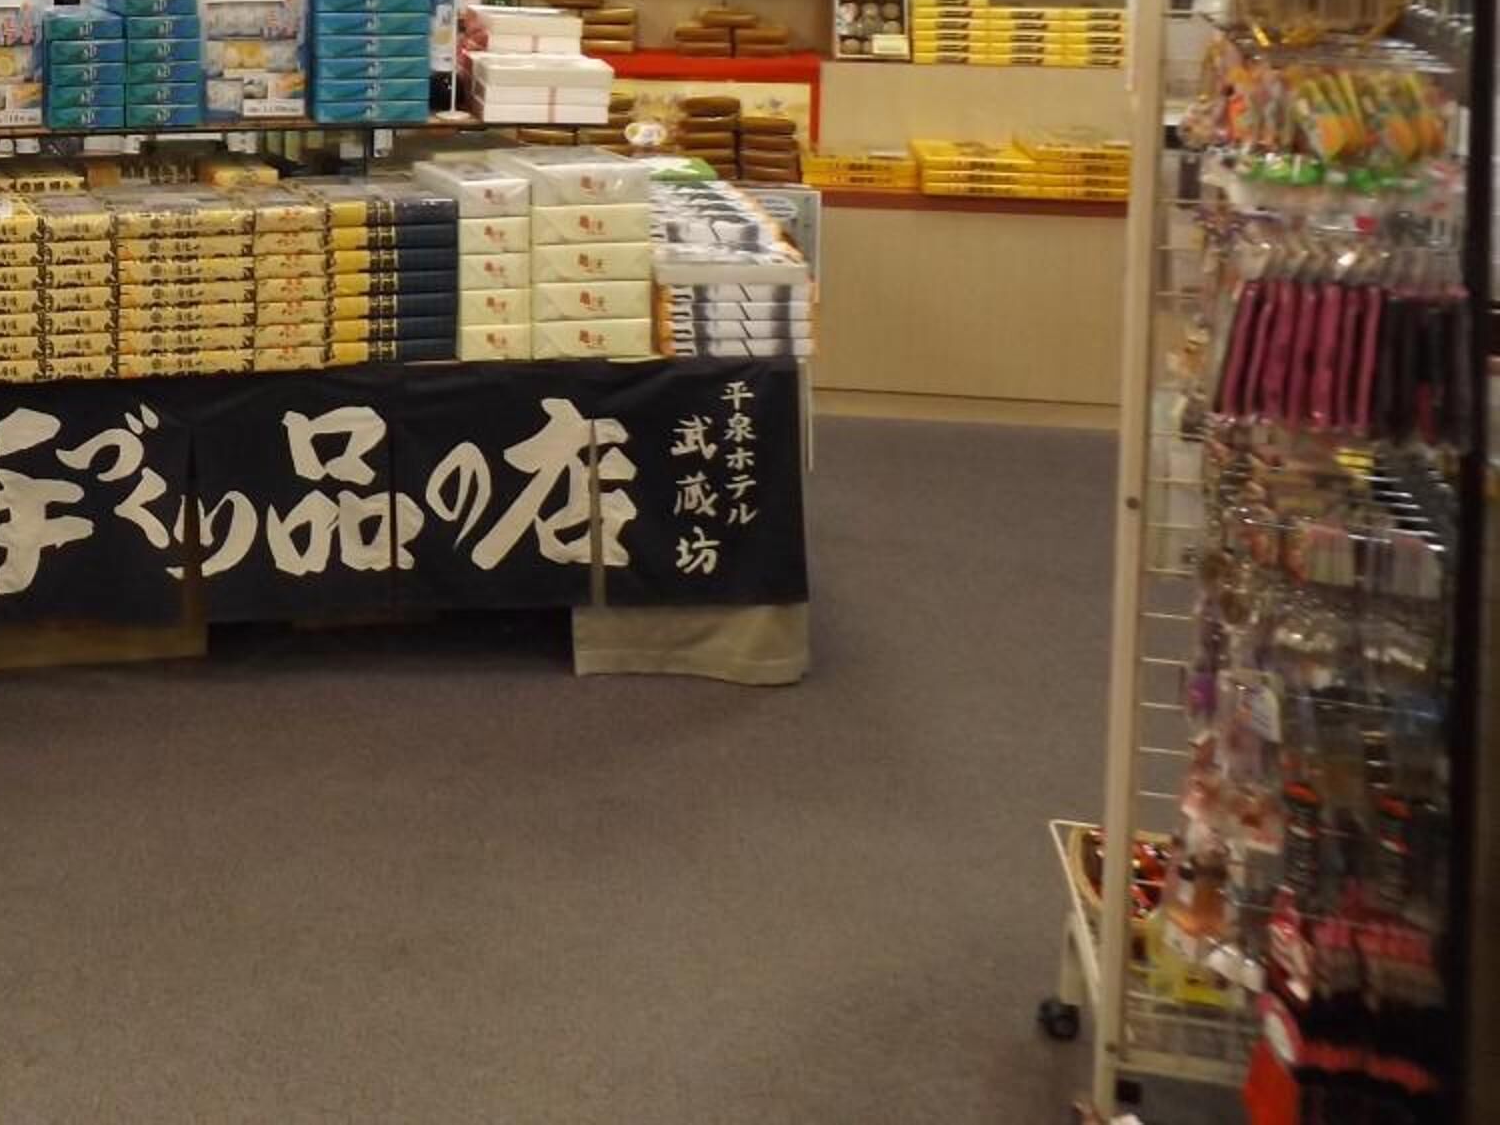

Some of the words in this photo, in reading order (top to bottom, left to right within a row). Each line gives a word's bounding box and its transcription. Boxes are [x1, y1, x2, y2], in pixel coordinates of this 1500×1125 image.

[669, 415, 722, 575] 武蔵坊
[720, 380, 758, 525] 平泉ホテル
